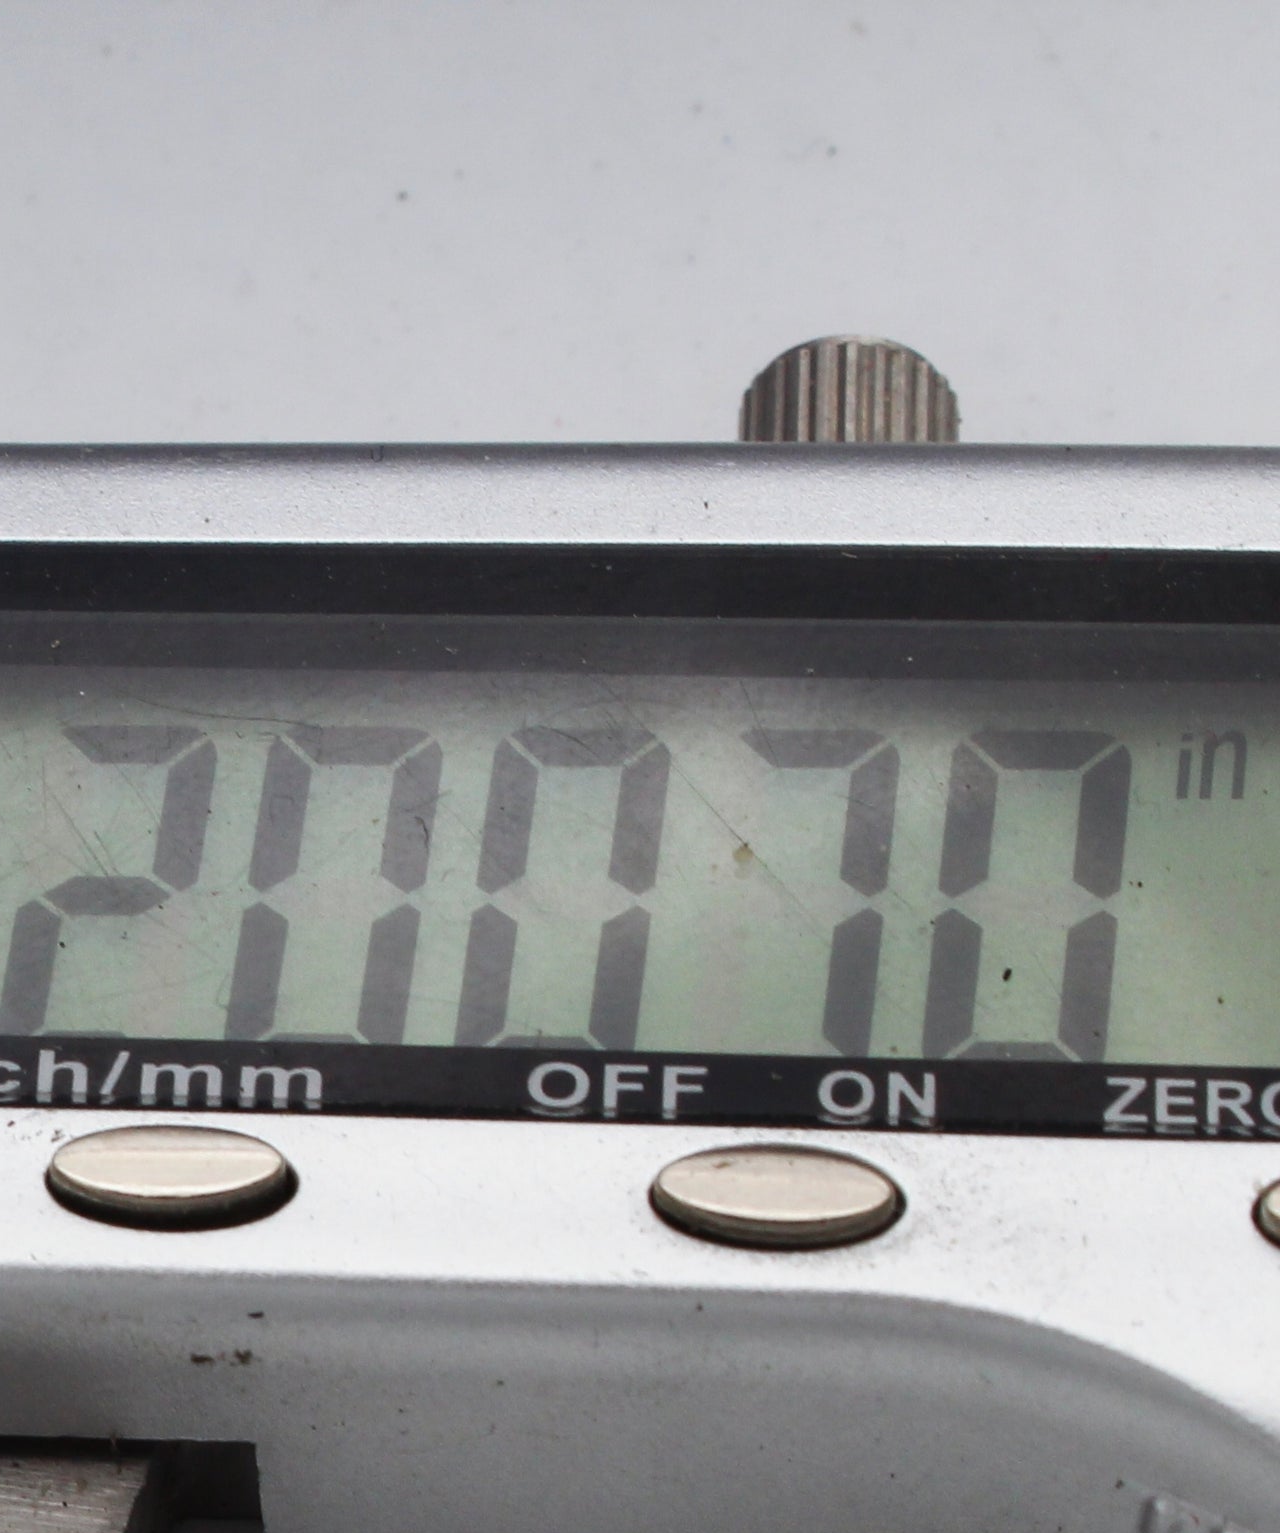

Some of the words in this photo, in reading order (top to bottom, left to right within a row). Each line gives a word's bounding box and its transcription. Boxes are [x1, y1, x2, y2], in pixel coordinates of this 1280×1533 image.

[1176, 730, 1248, 801] in
[526, 1061, 709, 1112] OFF
[817, 1070, 938, 1120] ON
